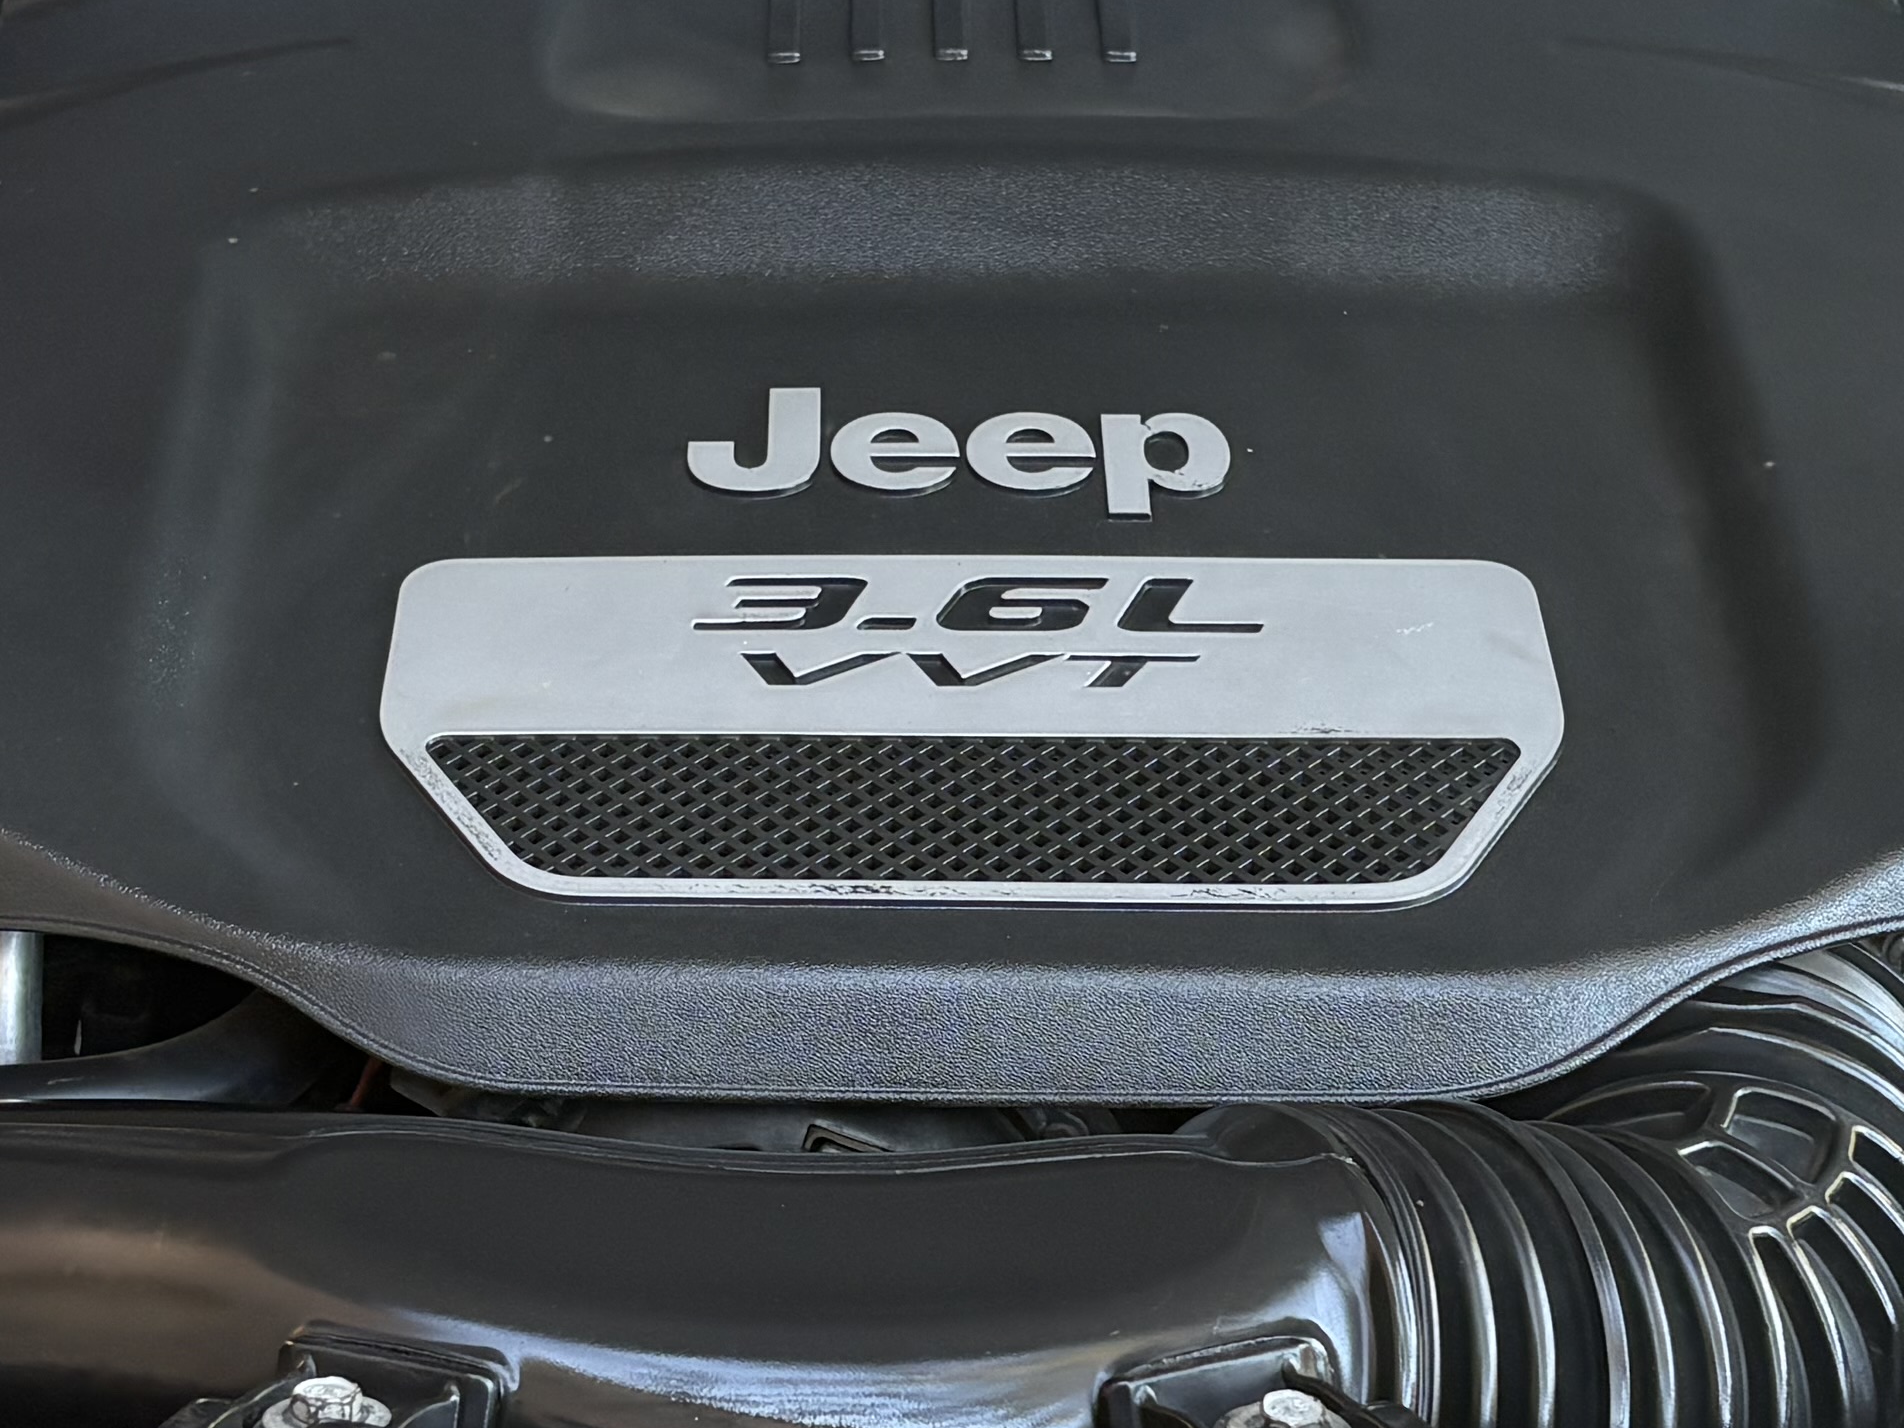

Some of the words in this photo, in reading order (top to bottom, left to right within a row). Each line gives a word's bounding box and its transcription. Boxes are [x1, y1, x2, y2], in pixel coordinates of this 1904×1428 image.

[687, 387, 1231, 522] Jeep
[692, 576, 1264, 633] 3.6L
[739, 650, 1201, 687] VVT
